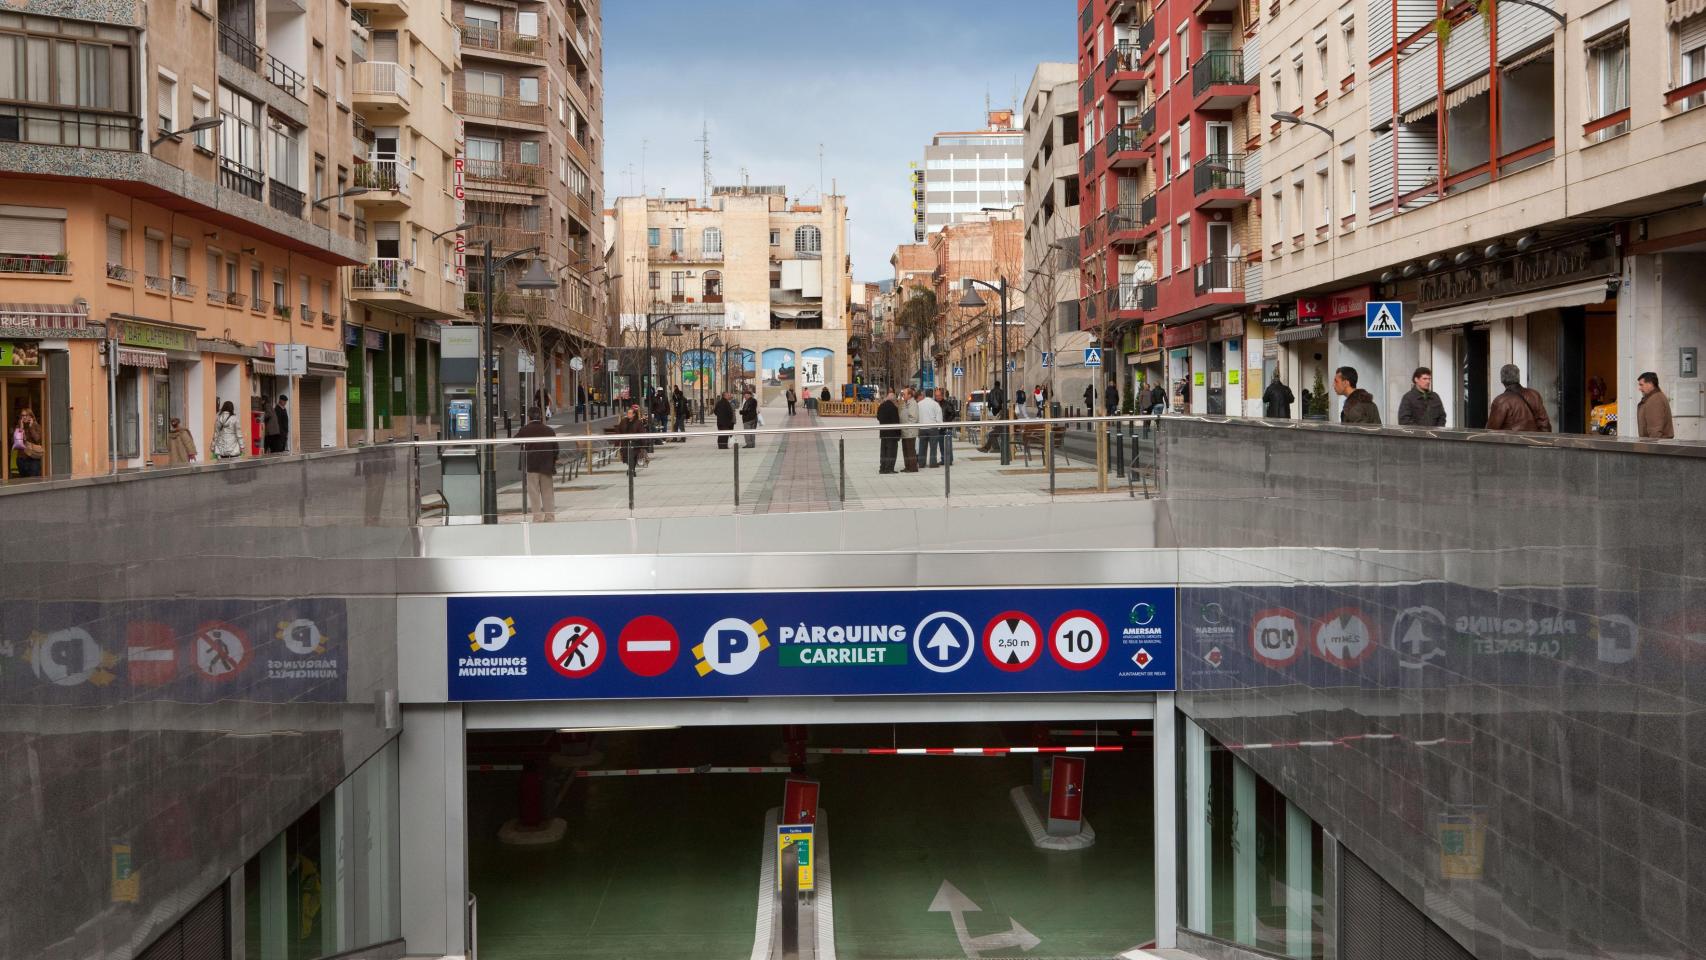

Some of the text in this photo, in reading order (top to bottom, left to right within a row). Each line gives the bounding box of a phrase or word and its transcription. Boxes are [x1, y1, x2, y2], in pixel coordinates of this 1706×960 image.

[484, 624, 502, 644] P
[779, 622, 906, 643] PÀRQUING
[1063, 630, 1093, 652] 10
[718, 629, 748, 663] P
[998, 639, 1018, 648] 2,50
[459, 656, 527, 667] PÀRQUINGS
[800, 648, 886, 663] CARRILET
[459, 667, 527, 677] MUNICIPALS
